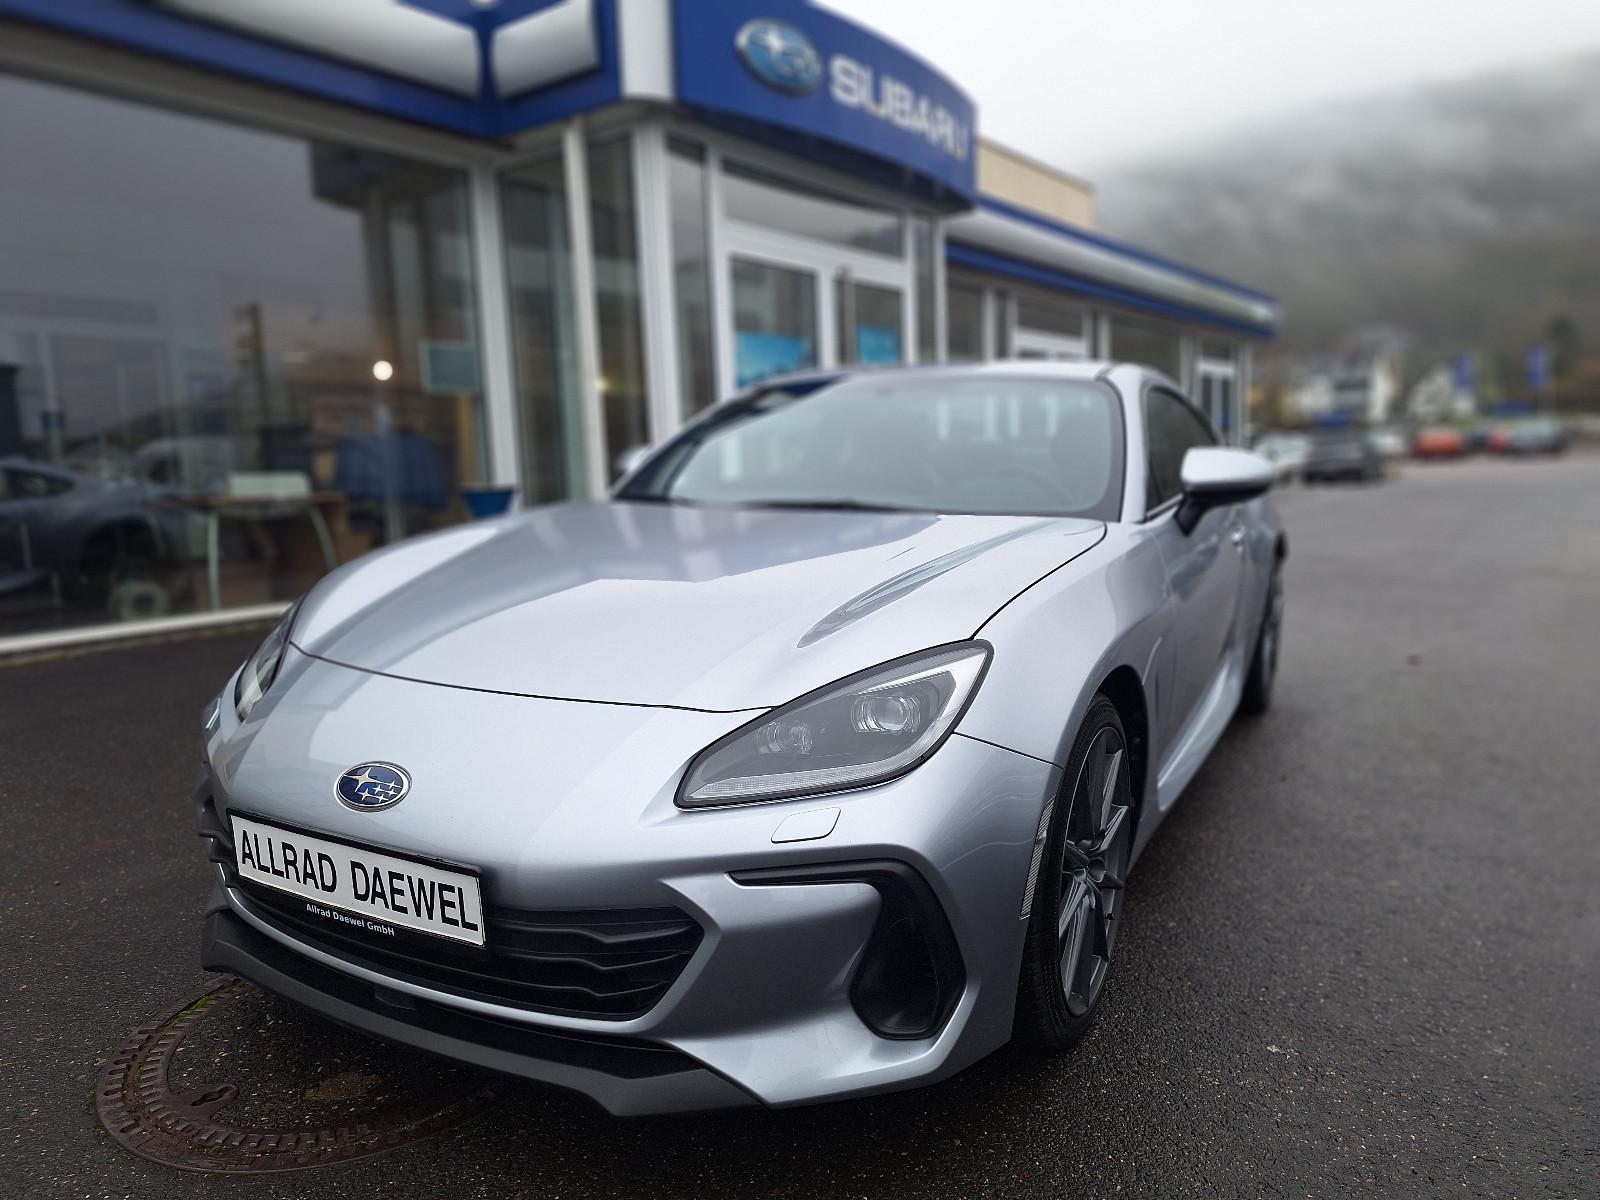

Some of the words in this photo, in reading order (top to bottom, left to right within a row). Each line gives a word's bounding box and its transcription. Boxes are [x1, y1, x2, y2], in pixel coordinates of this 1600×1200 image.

[242, 830, 336, 893] ALLRAD
[350, 861, 479, 931] DAEWEL
[306, 903, 331, 918] Allrad
[332, 911, 365, 928] Daewel
[366, 921, 395, 936] GmbH
